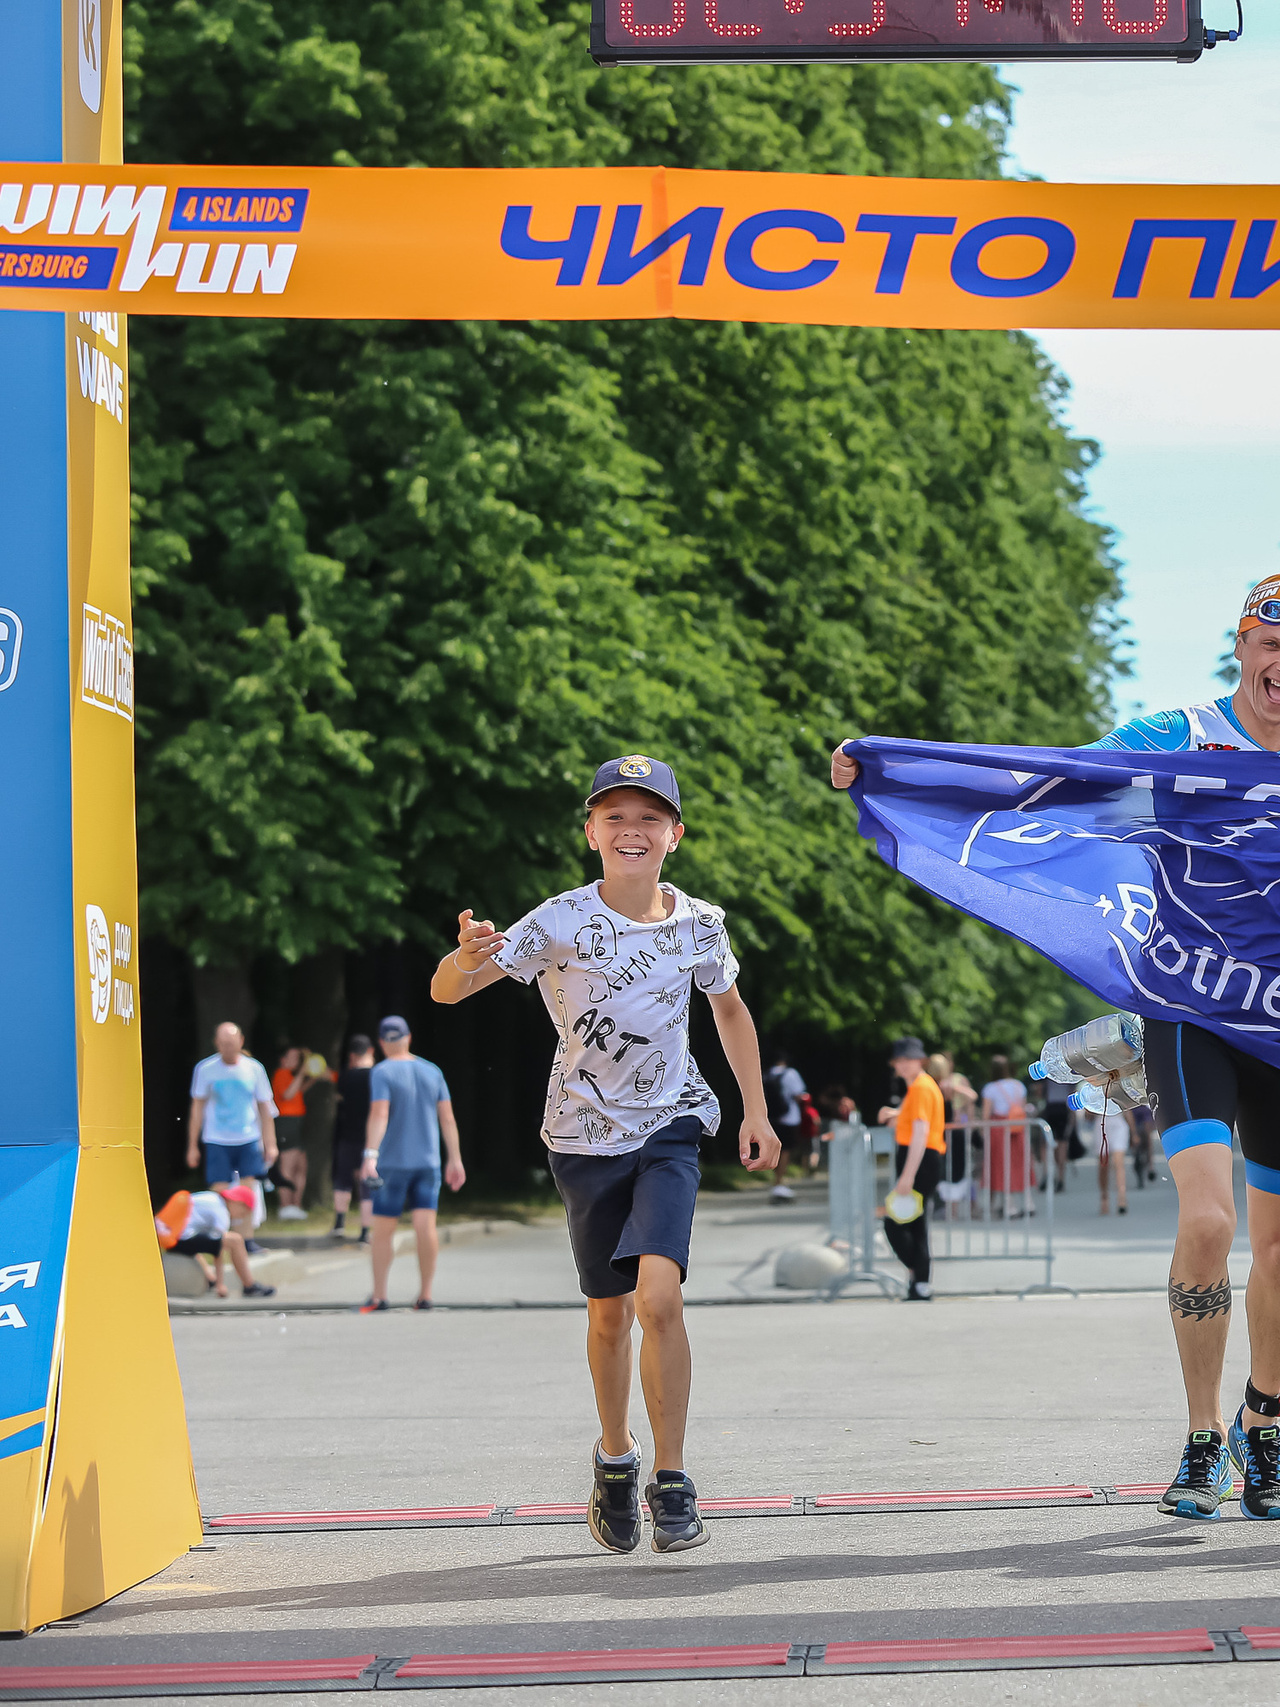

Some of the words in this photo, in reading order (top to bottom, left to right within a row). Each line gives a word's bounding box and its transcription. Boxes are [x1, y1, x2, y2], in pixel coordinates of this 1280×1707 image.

[182, 196, 199, 222] 4
[200, 196, 295, 223] ISLANDS
[0, 252, 89, 280] RSBURG
[499, 204, 1077, 298] ЧИСТО
[75, 335, 123, 425] WAVE
[85, 617, 116, 699] World
[572, 1008, 652, 1063] ART
